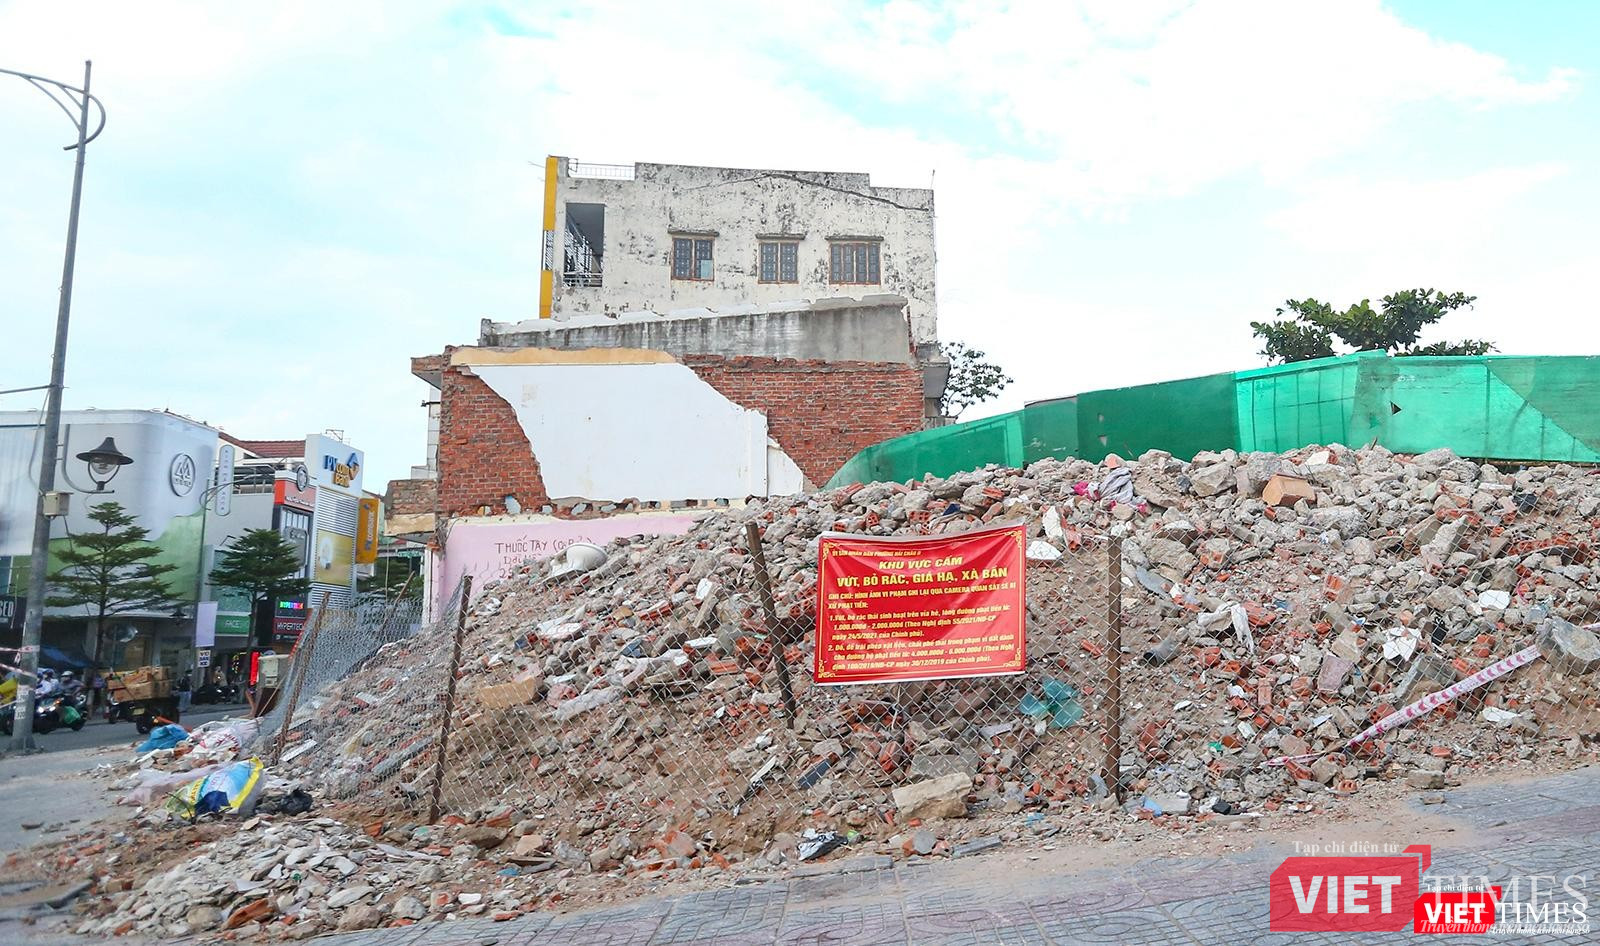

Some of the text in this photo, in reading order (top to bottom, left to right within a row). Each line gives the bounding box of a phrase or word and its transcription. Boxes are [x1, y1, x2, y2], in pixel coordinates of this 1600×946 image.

[495, 535, 528, 554] THUỐC
[530, 540, 548, 551] TÂY
[879, 555, 963, 570] KHU VỰC CẤM
[863, 573, 878, 586] BỎ
[944, 586, 970, 594] CAMERA
